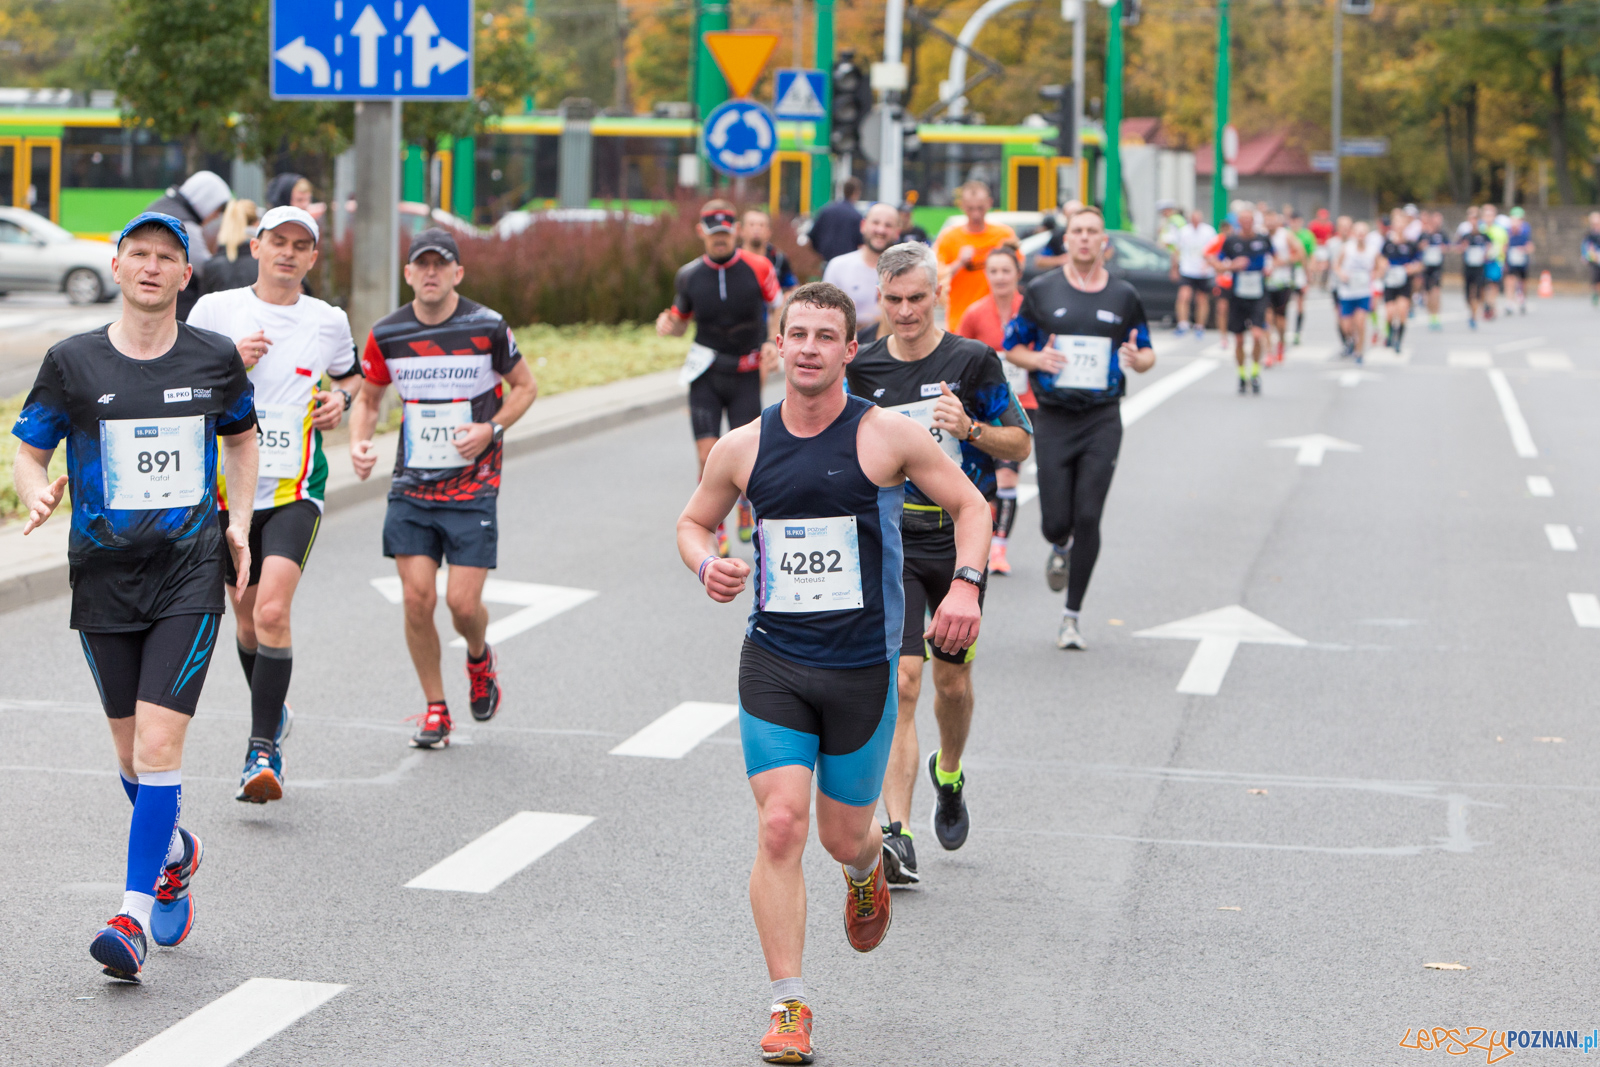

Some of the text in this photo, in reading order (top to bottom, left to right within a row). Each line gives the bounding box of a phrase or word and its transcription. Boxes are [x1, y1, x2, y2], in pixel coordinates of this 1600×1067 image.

[1073, 353, 1098, 368] 775
[396, 366, 481, 380] BRIDGESTONE
[137, 450, 180, 473] 891
[780, 550, 843, 575] 4282
